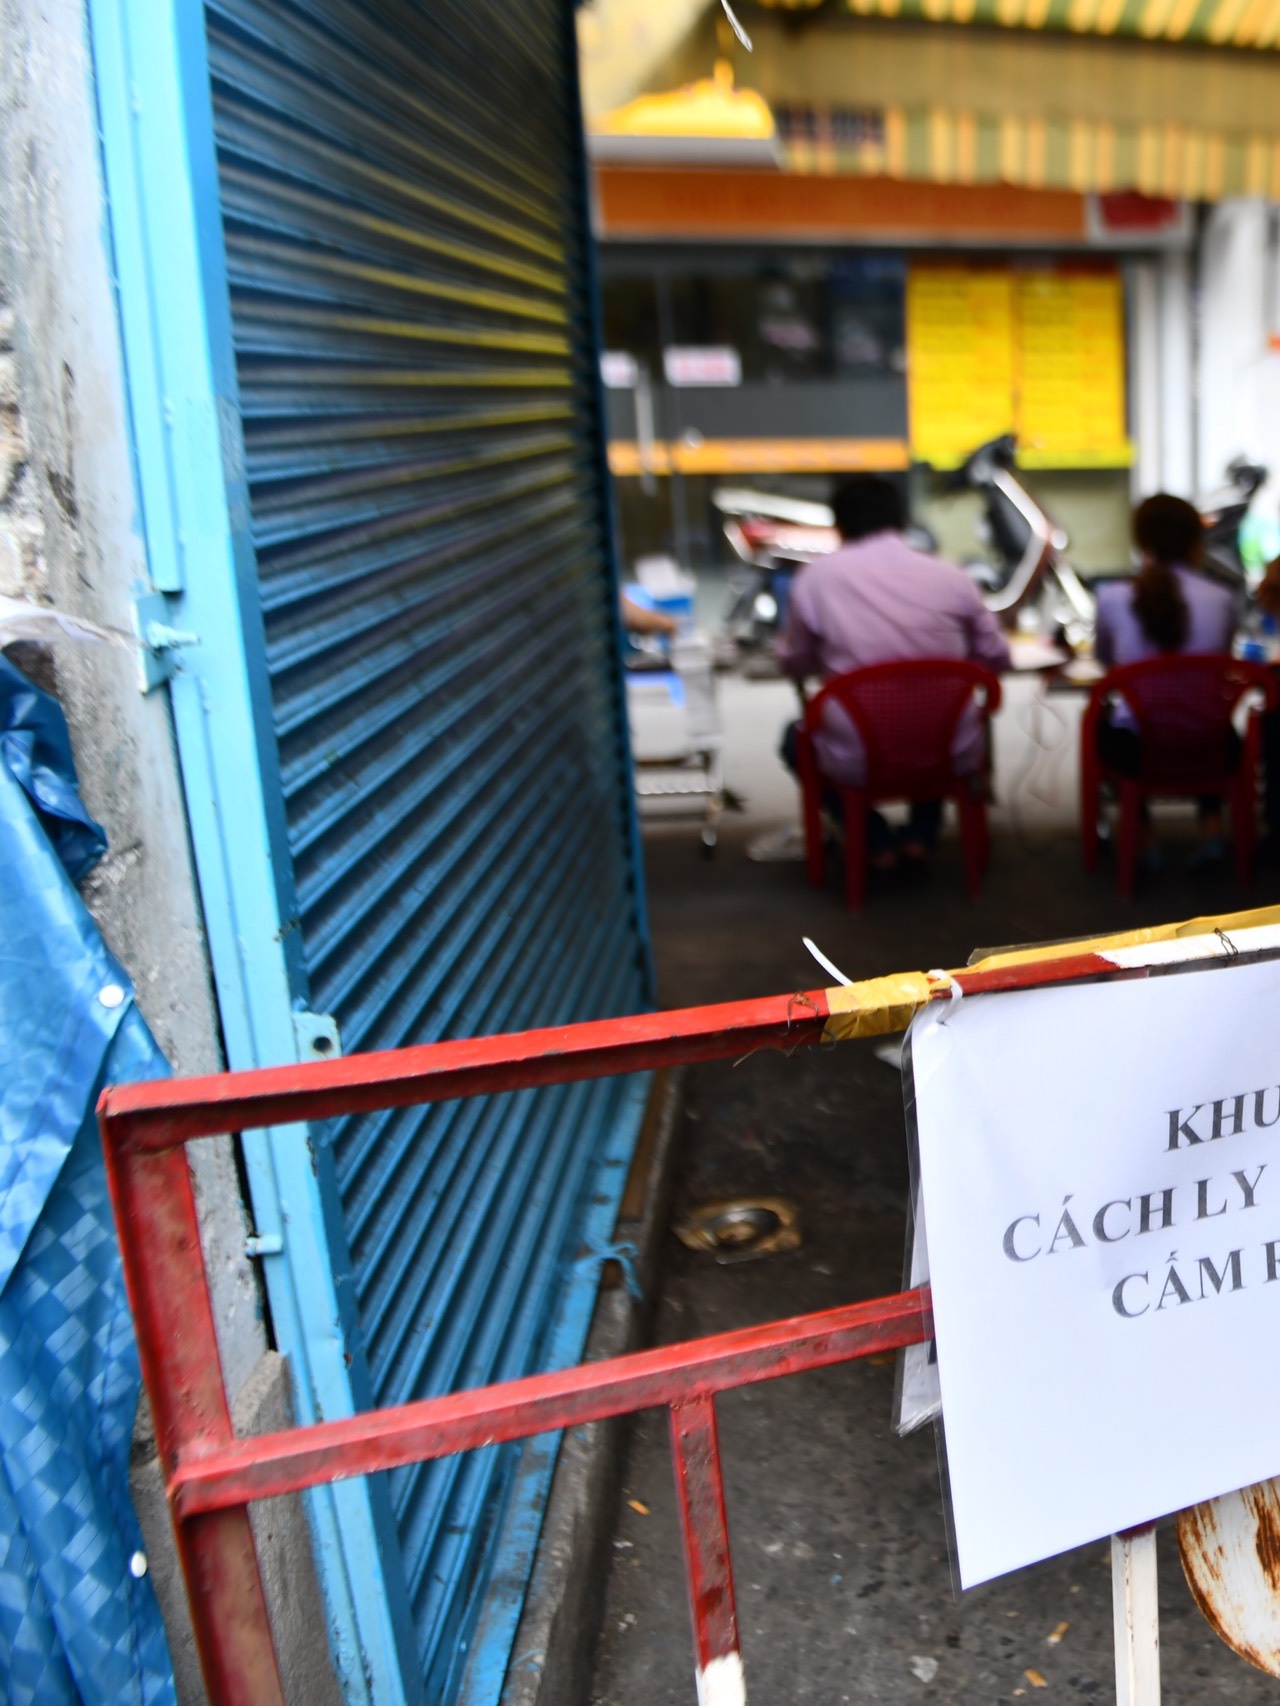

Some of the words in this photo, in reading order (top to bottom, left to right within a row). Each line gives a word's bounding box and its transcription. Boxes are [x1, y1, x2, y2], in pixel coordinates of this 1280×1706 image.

[1002, 1186, 1178, 1263] CÁCH
[1193, 1163, 1268, 1221] LY
[1111, 1248, 1246, 1319] CẤM
